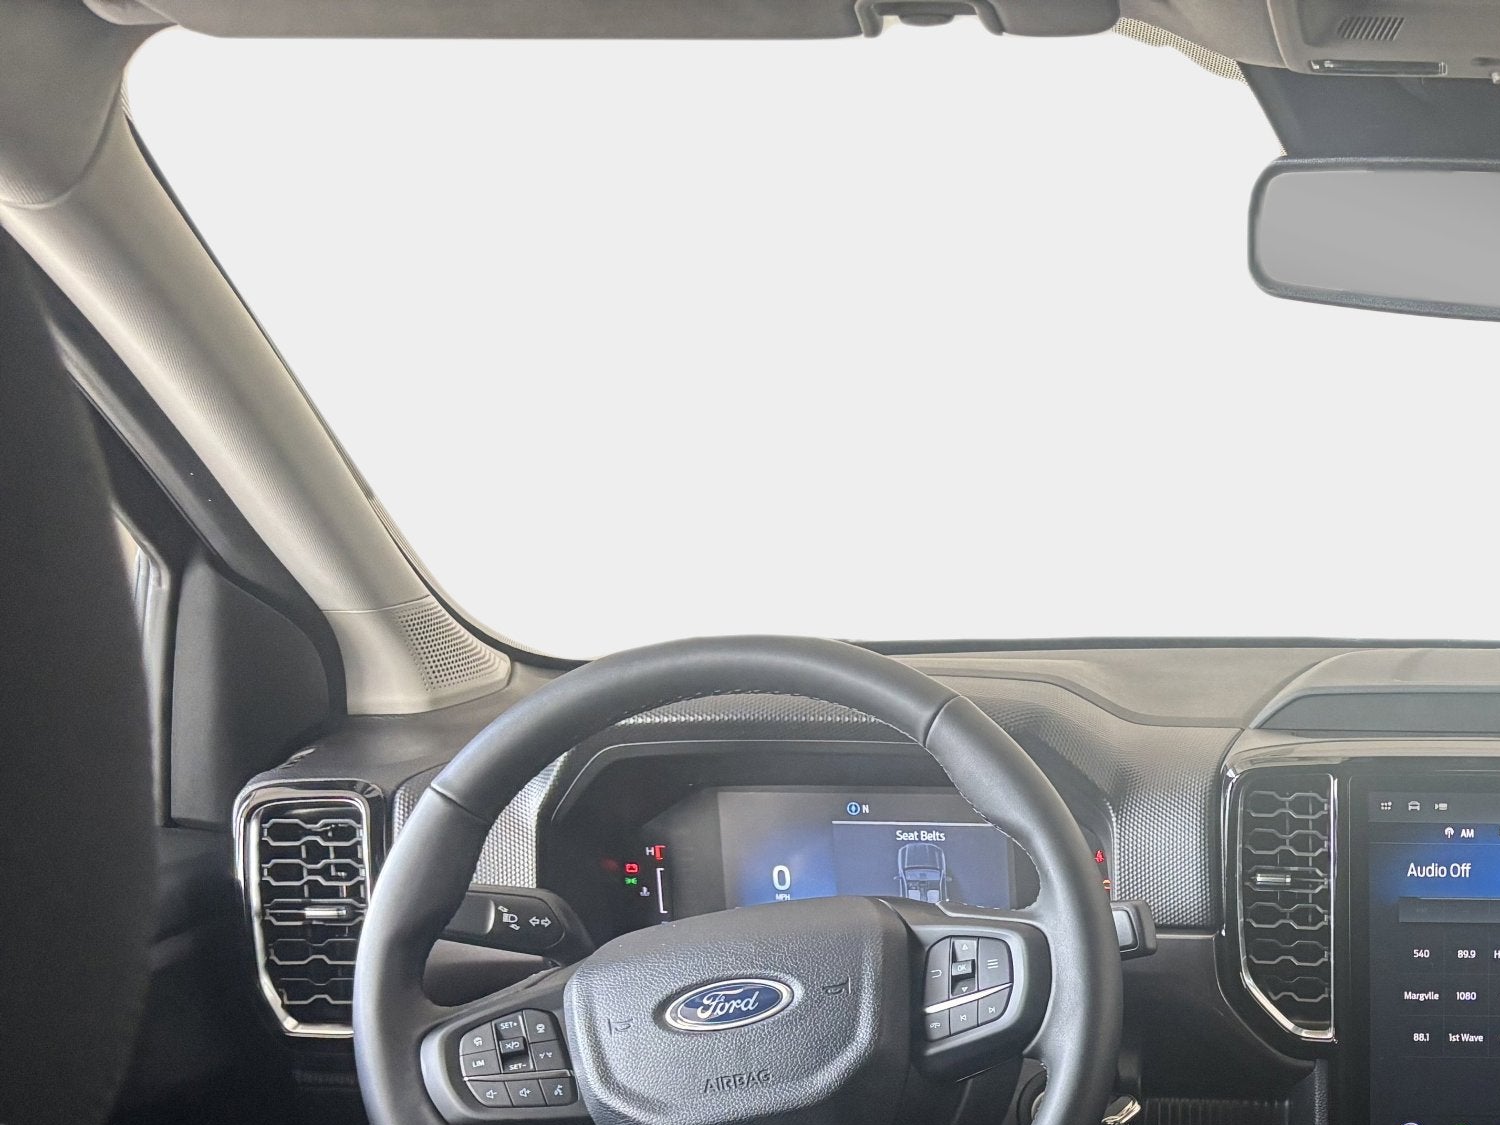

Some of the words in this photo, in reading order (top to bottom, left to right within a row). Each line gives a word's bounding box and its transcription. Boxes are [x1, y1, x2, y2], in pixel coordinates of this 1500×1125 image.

[862, 805, 869, 813] N
[896, 830, 918, 841] Seat
[921, 831, 945, 842] Belts
[1460, 829, 1474, 838] AM
[1407, 863, 1446, 877] Audio
[1450, 863, 1471, 877] Off
[772, 865, 791, 891] 0
[1413, 950, 1430, 958] 540
[1458, 950, 1476, 958] 89.9
[1456, 992, 1476, 1000] 1080
[697, 988, 760, 1018] Ford
[1413, 1033, 1429, 1041] 88.1
[1449, 1033, 1459, 1041] 1st
[1461, 1034, 1483, 1042] Wave
[472, 1059, 485, 1067] LIM
[704, 1069, 771, 1093] AIRBAG
